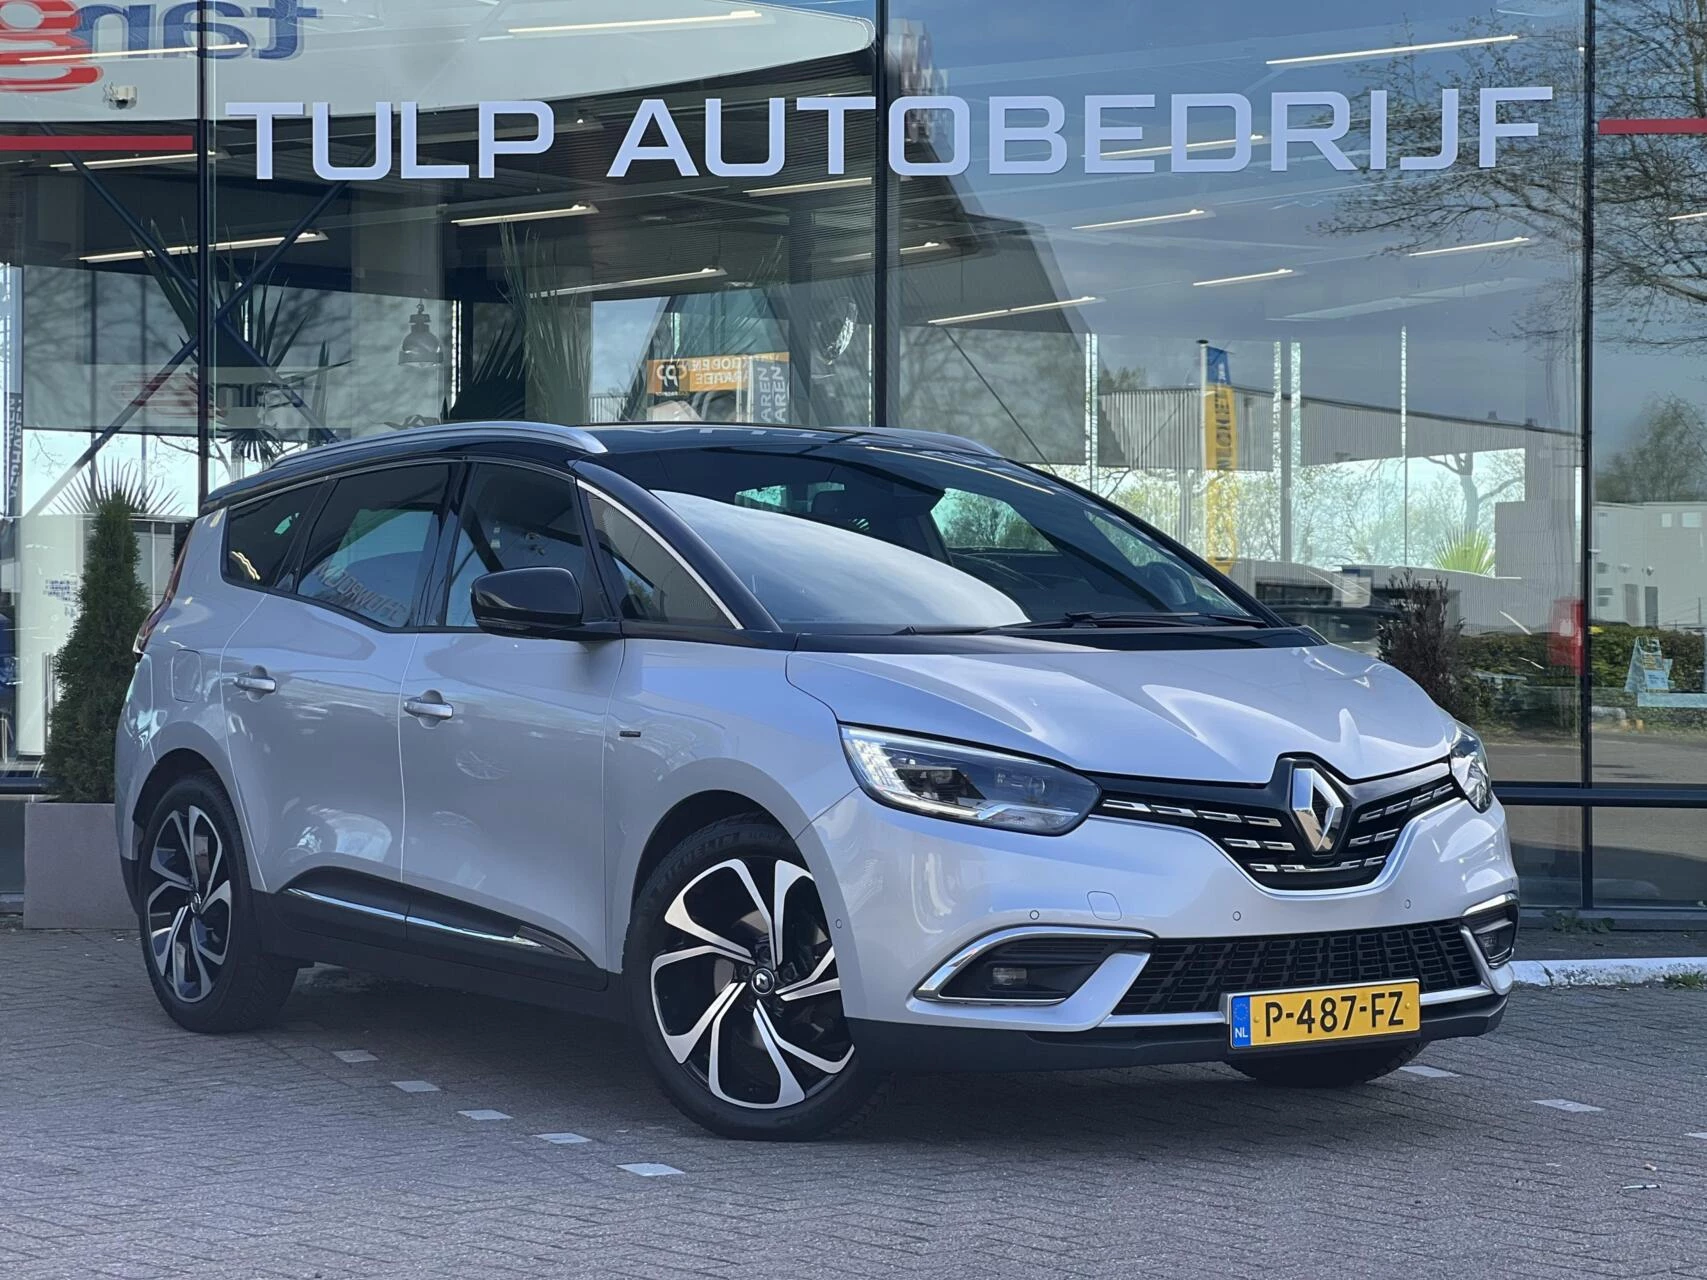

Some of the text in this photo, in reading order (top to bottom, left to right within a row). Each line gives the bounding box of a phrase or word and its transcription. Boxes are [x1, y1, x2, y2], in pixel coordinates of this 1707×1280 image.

[225, 86, 1553, 181] TULP AUTOBEDRIJF
[1234, 991, 1404, 1039] NL P-487-FZ
